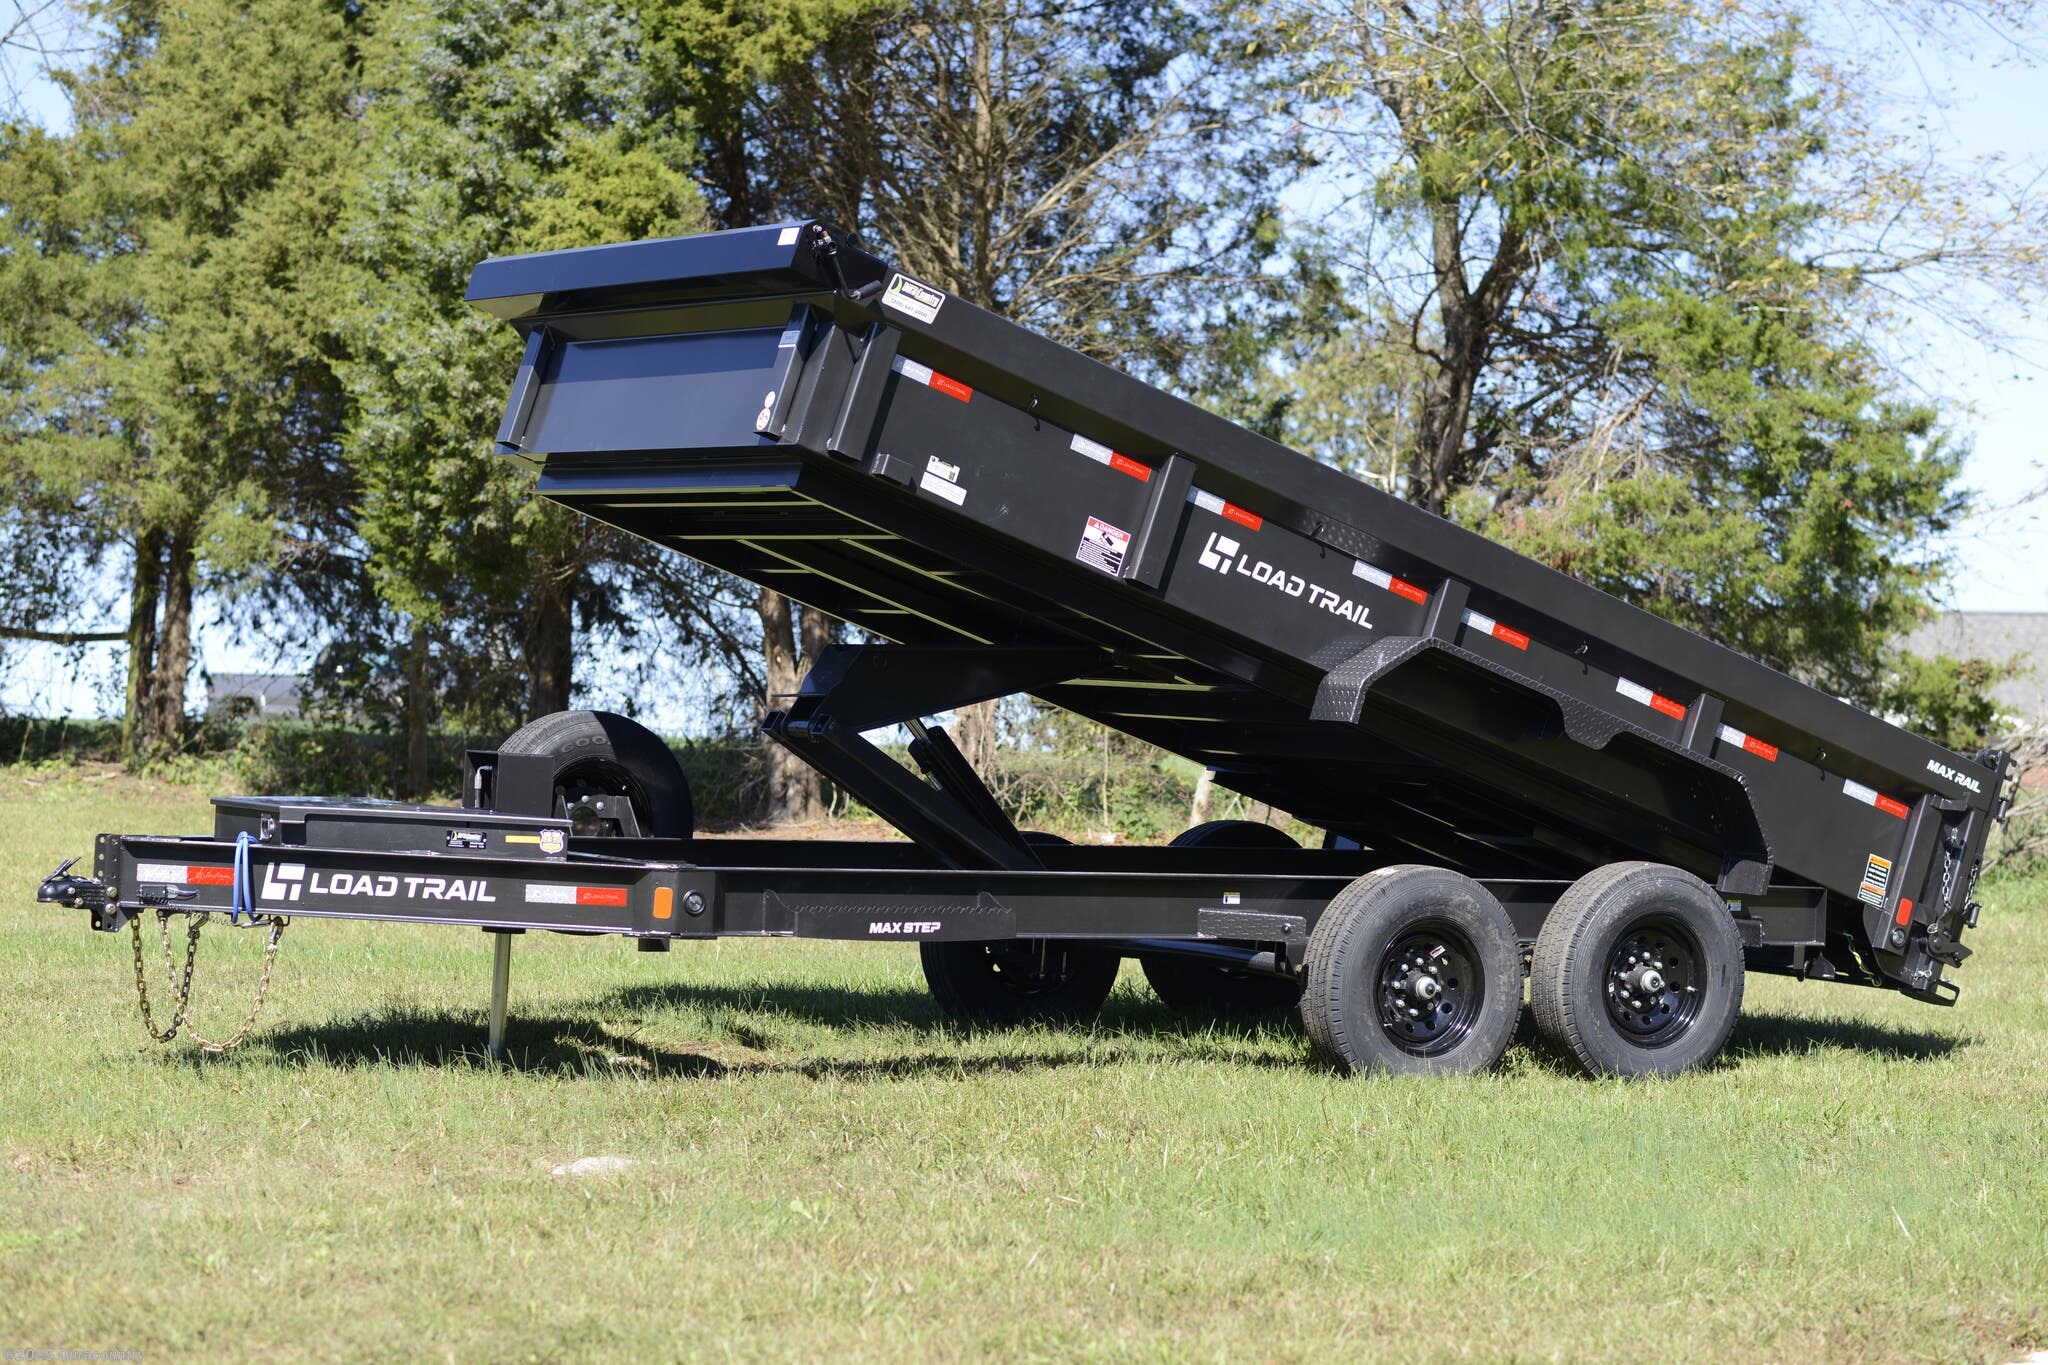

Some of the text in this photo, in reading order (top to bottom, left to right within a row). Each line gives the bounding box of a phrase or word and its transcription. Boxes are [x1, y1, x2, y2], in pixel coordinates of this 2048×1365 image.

[1100, 523, 1124, 539] DANGER
[1237, 554, 1373, 630] LOAD TRAIL
[1927, 759, 1981, 794] MAX RAIL
[309, 872, 496, 902] LOAD TRAIL
[869, 921, 941, 934] MAX STEP
